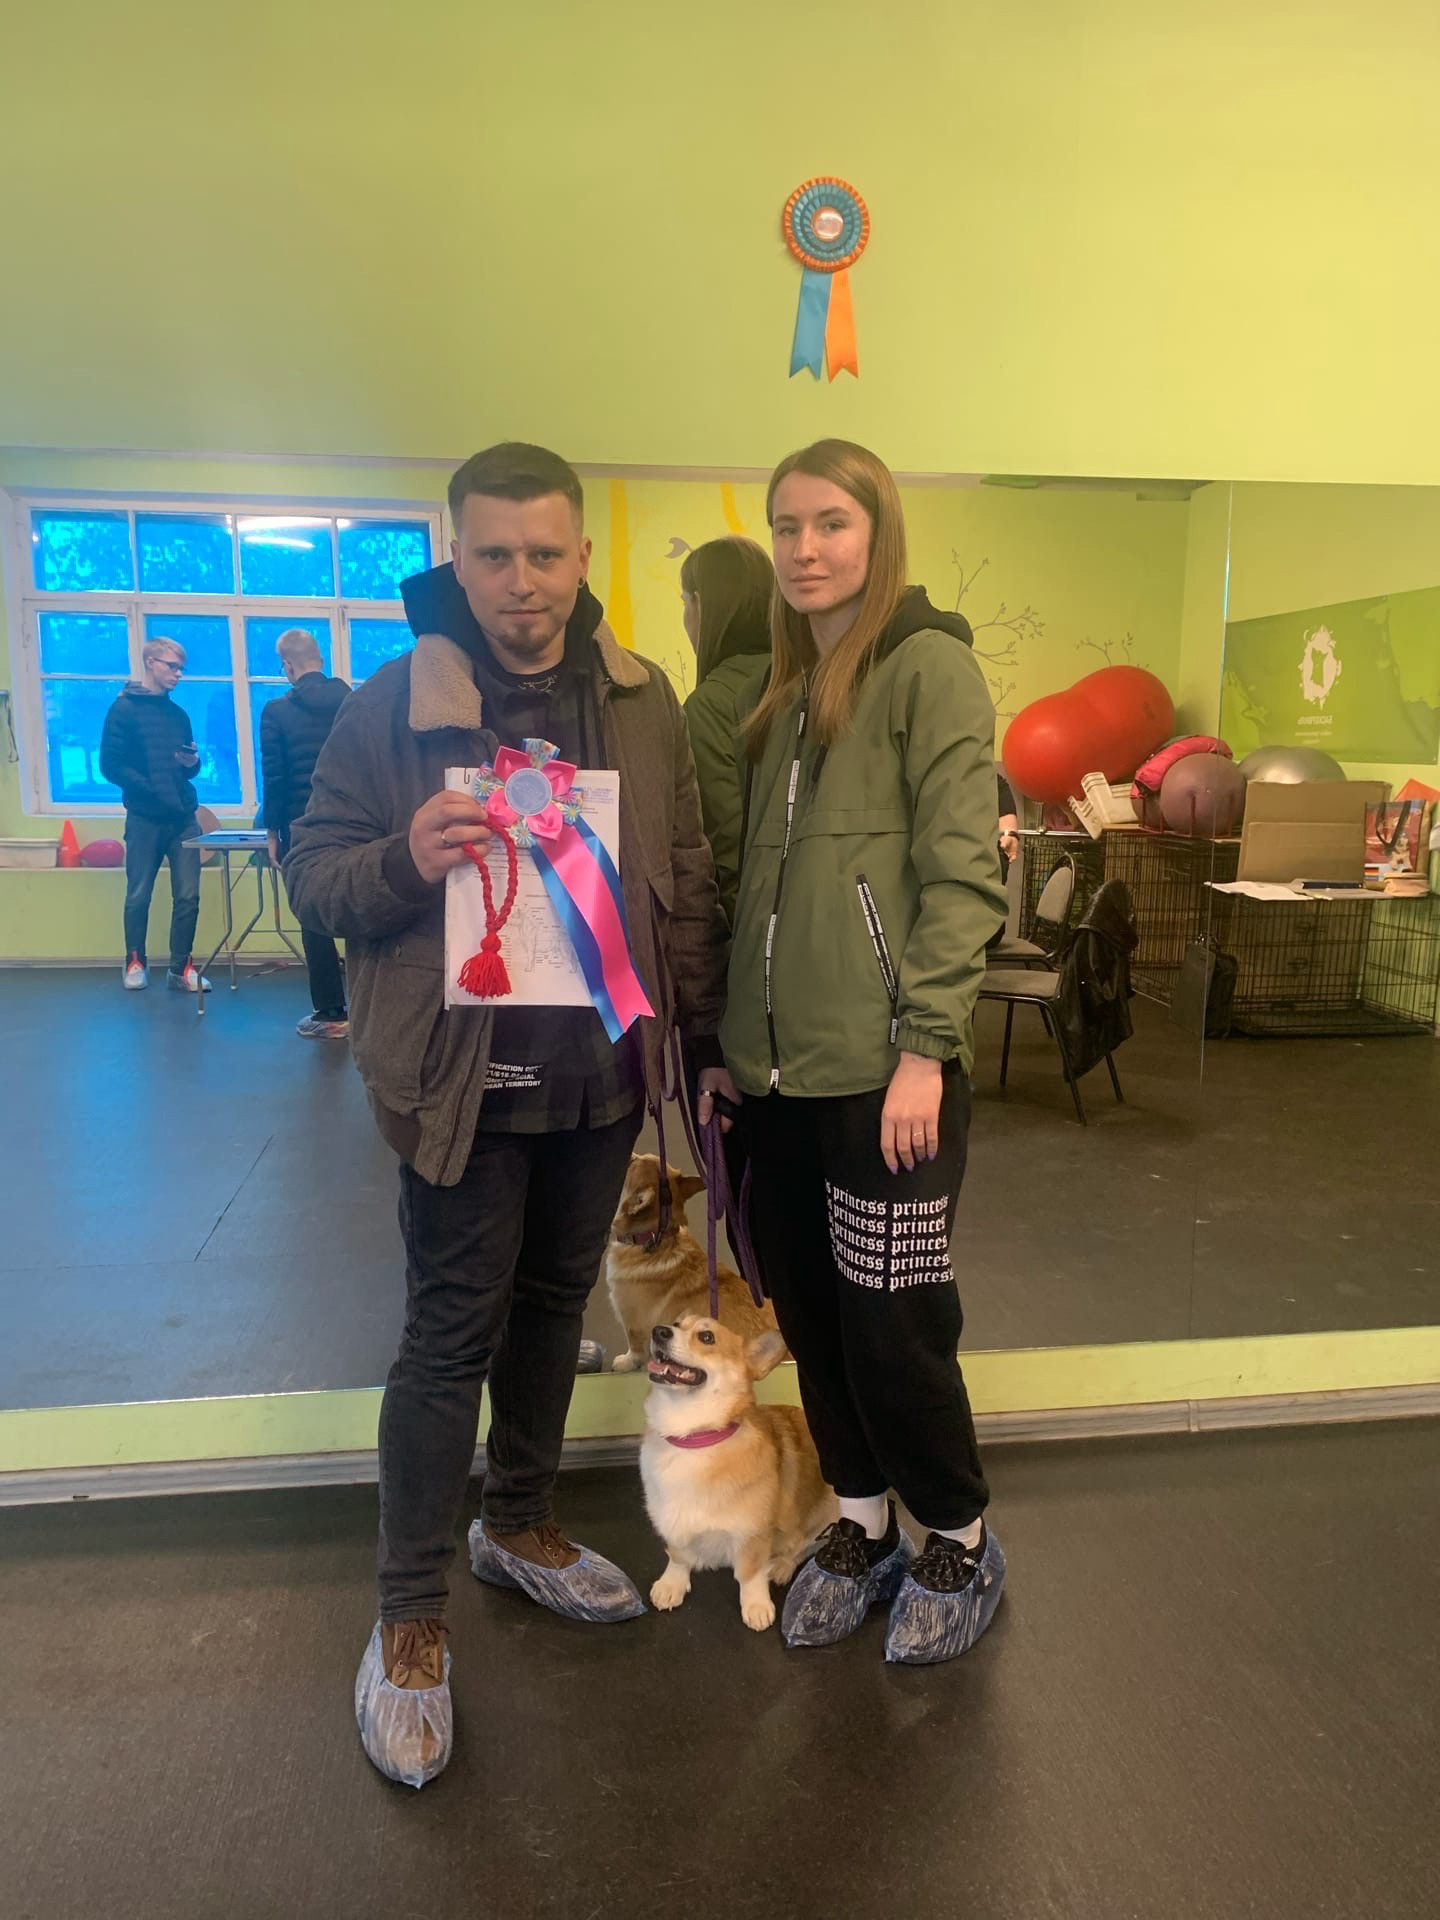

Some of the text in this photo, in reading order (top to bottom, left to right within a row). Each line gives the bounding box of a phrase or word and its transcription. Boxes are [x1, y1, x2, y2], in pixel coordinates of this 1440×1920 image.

[505, 1080, 542, 1088] TERRITORY
[832, 1186, 887, 1216] princess
[833, 1203, 887, 1234] princess
[835, 1221, 886, 1253] princess
